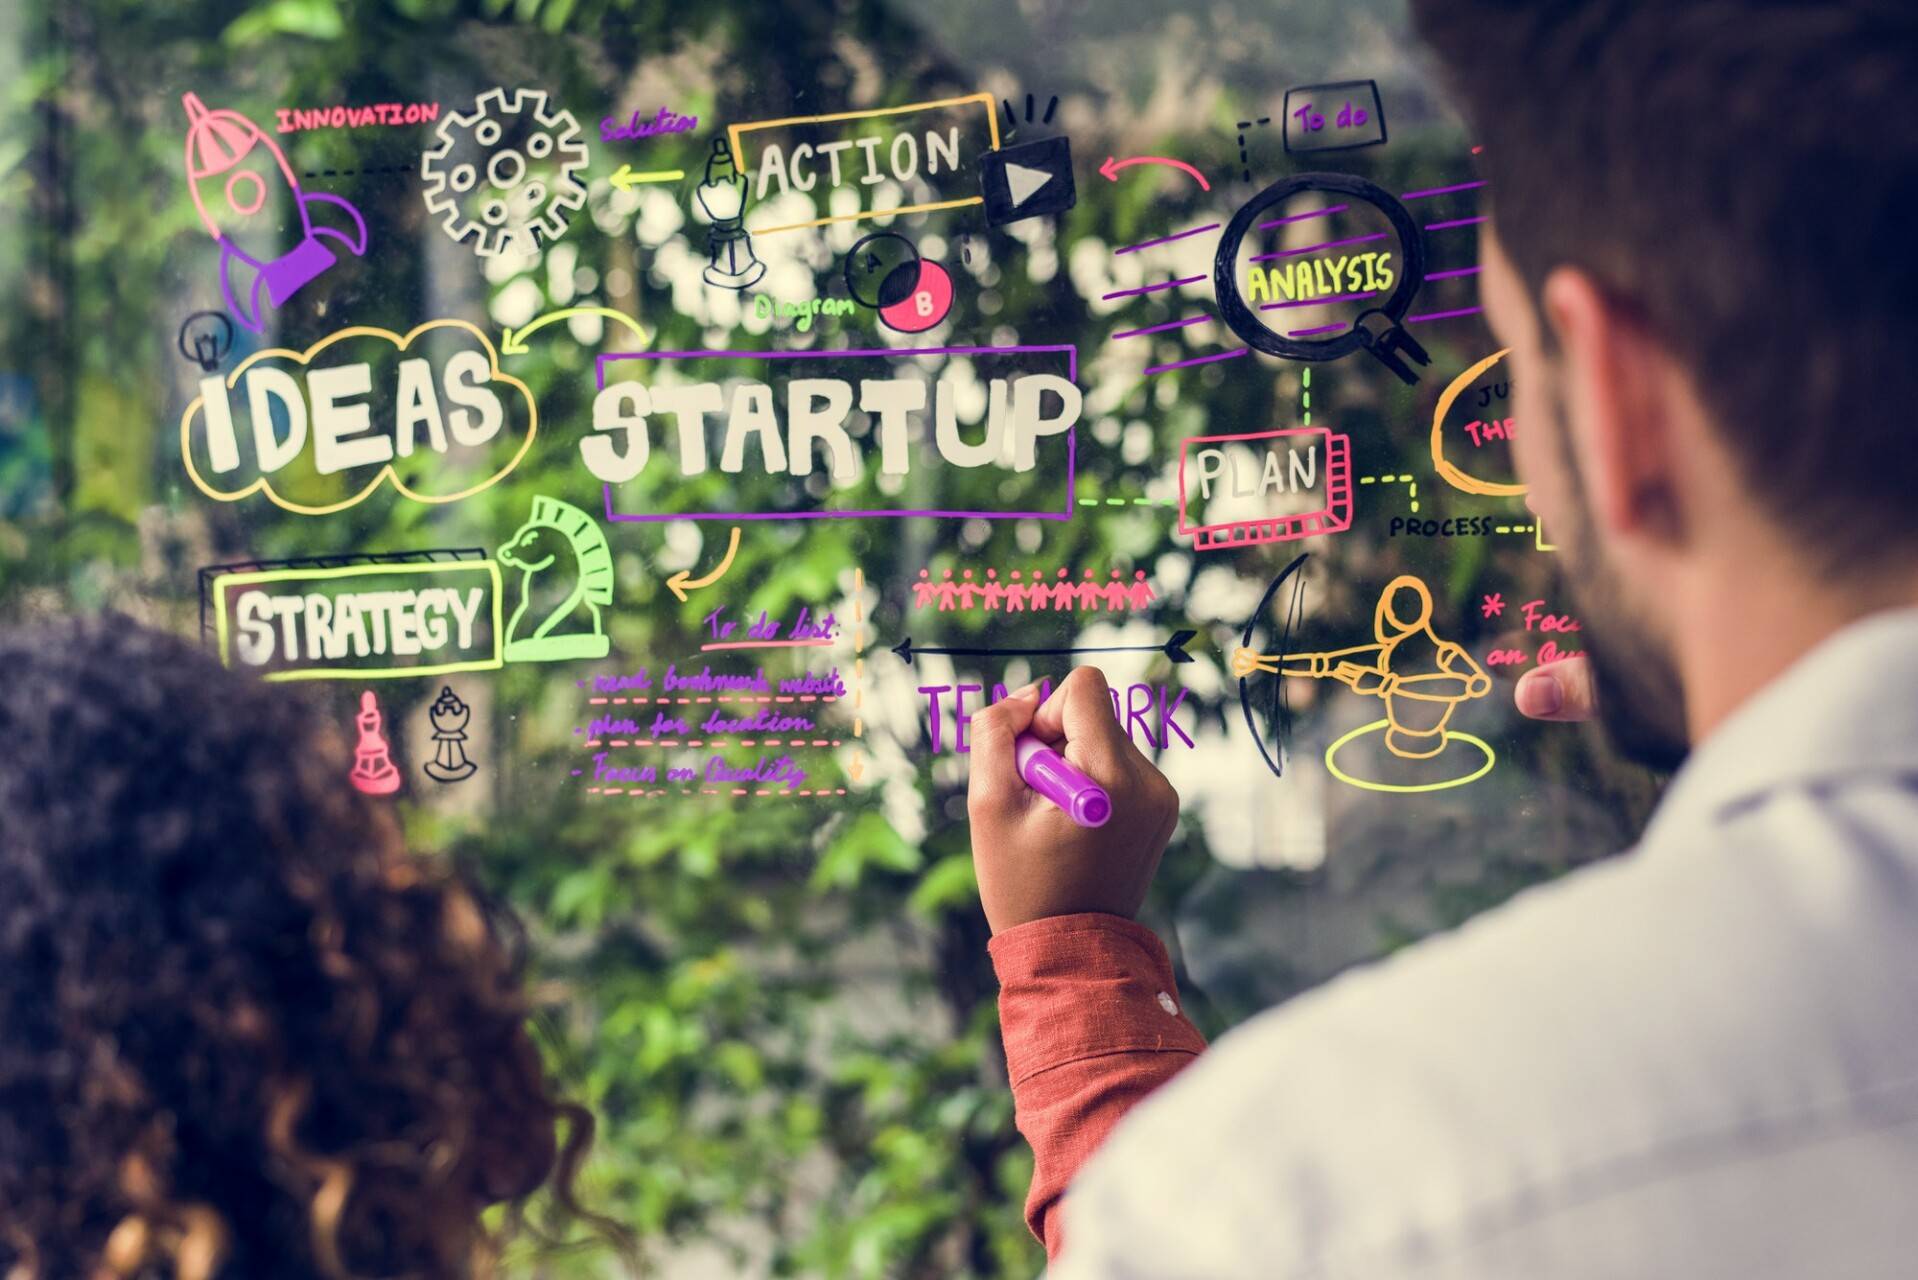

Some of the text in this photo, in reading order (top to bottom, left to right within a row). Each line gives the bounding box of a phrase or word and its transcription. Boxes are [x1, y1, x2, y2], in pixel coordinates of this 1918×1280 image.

[276, 103, 439, 134] INNOVATION
[599, 107, 699, 142] Solution
[1294, 101, 1368, 132] To do
[757, 127, 960, 200] ACTION
[866, 252, 882, 273] A
[1248, 252, 1394, 302] ANALYSIS
[755, 294, 856, 332] Diagram
[915, 290, 934, 317] B
[200, 350, 504, 475] IDEAS
[579, 374, 1083, 483] STARTUP
[1197, 446, 1317, 499] PLAN
[1390, 515, 1492, 537] PROCESS
[237, 587, 484, 665] STRATEGY
[703, 604, 737, 638] To
[748, 610, 781, 639] do
[779, 666, 847, 697] website
[586, 709, 815, 745] plan for location
[593, 752, 808, 790] Focus on Quality
